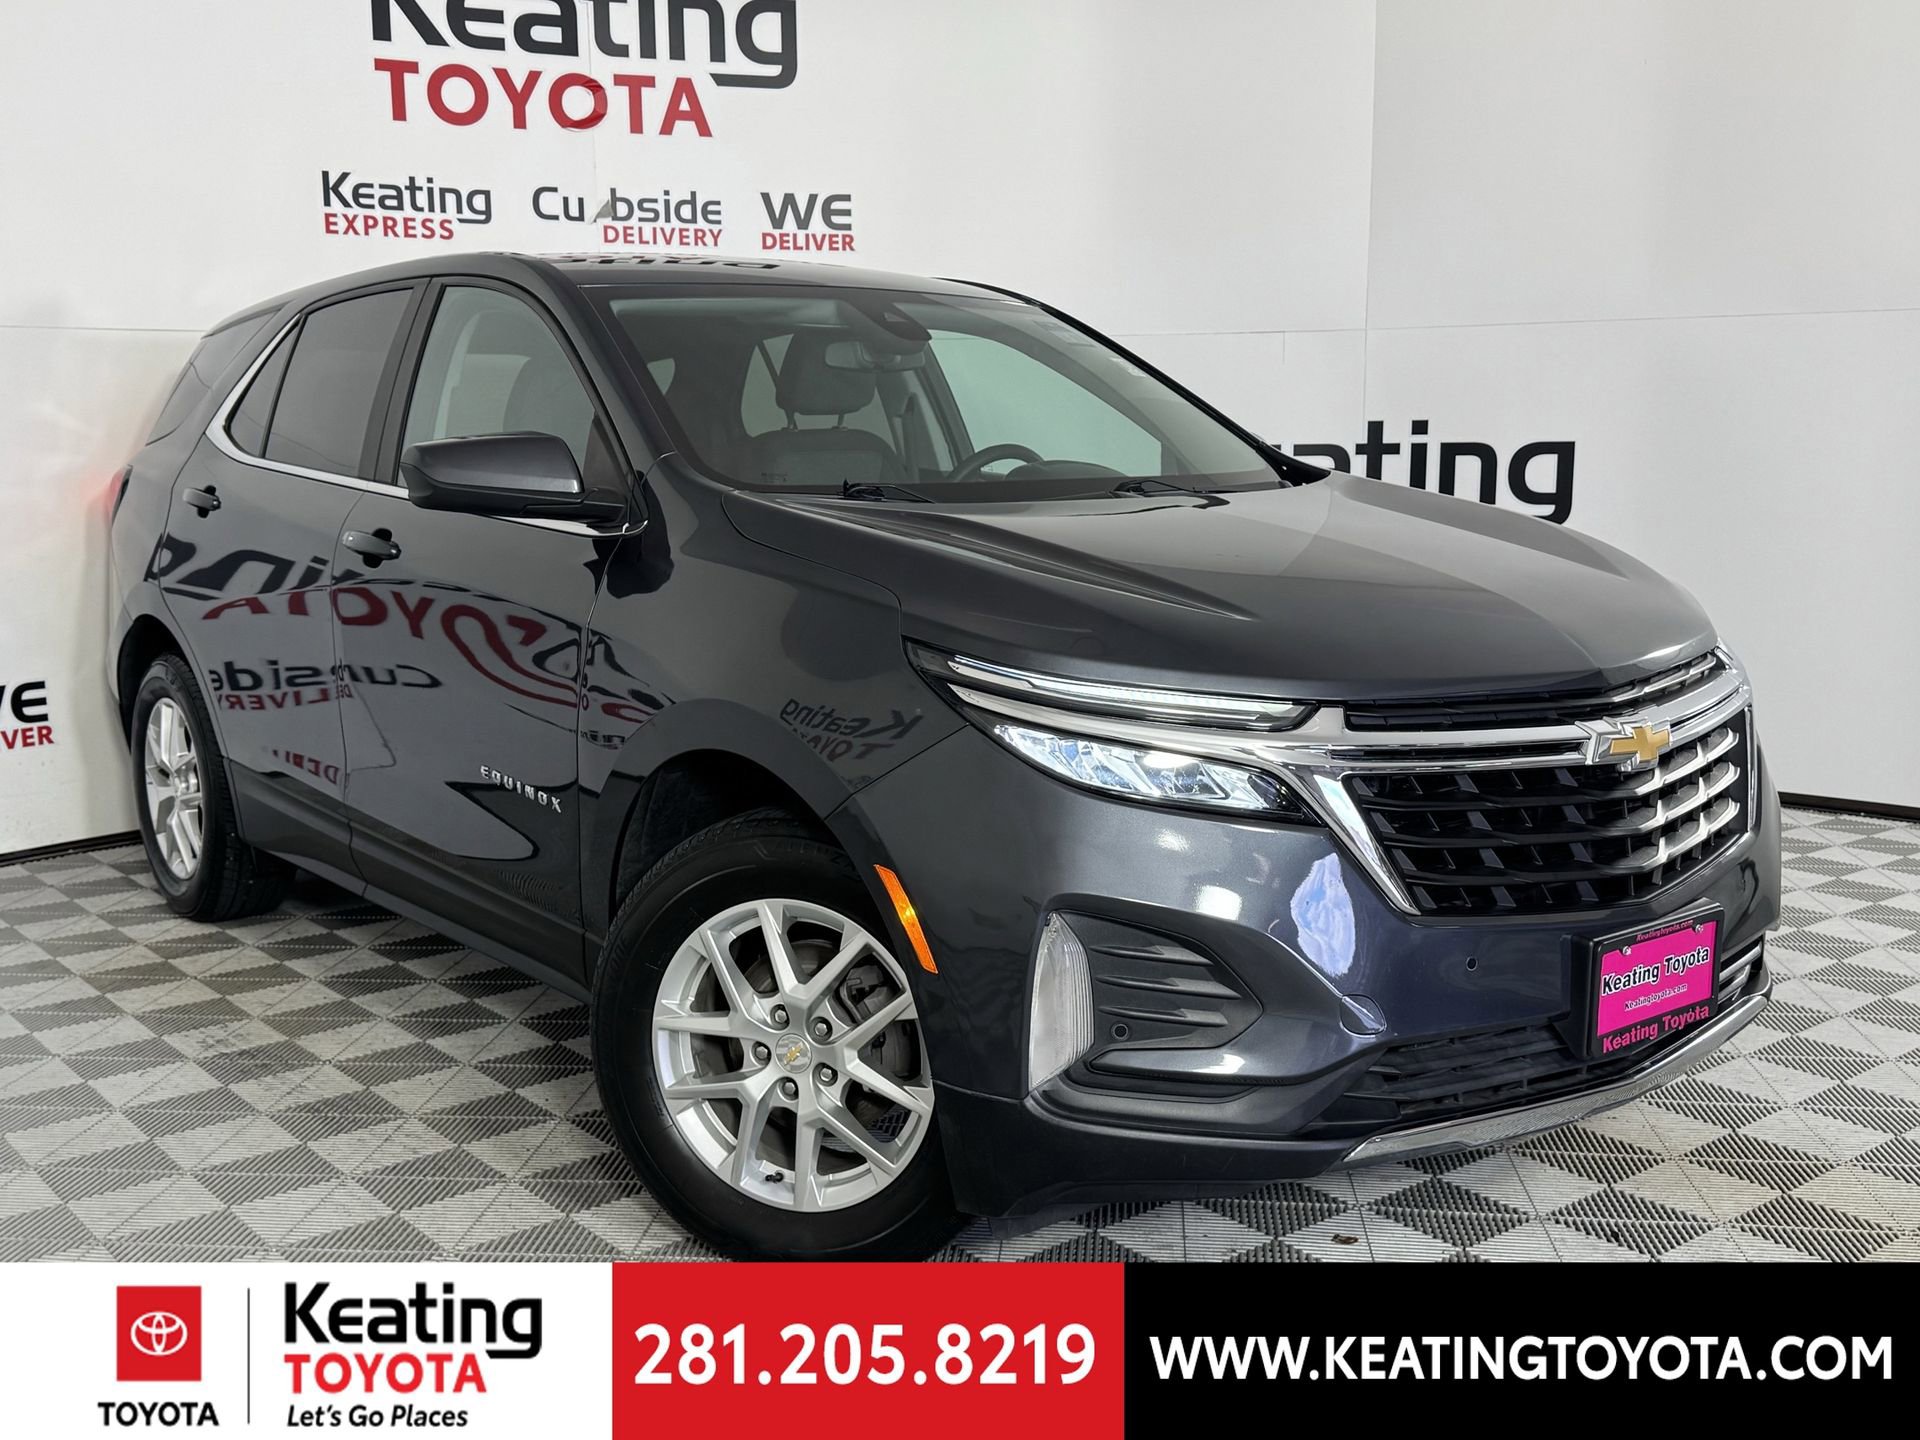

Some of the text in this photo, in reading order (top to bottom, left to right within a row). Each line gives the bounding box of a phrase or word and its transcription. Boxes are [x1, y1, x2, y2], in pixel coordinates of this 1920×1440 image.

[374, 57, 713, 138] TOYOTA
[321, 170, 492, 225] Keating
[532, 186, 722, 225] Cubside
[760, 192, 852, 231] WE
[324, 213, 454, 240] EXPRESS
[603, 225, 722, 247] DELIVERY
[762, 232, 855, 252] DELIVER
[1270, 419, 1576, 526] ting
[0, 680, 49, 724] E
[480, 765, 562, 814] EQUINOX
[1601, 947, 1709, 996] Keating Toyota
[1602, 1006, 1710, 1054] Keating Toyota
